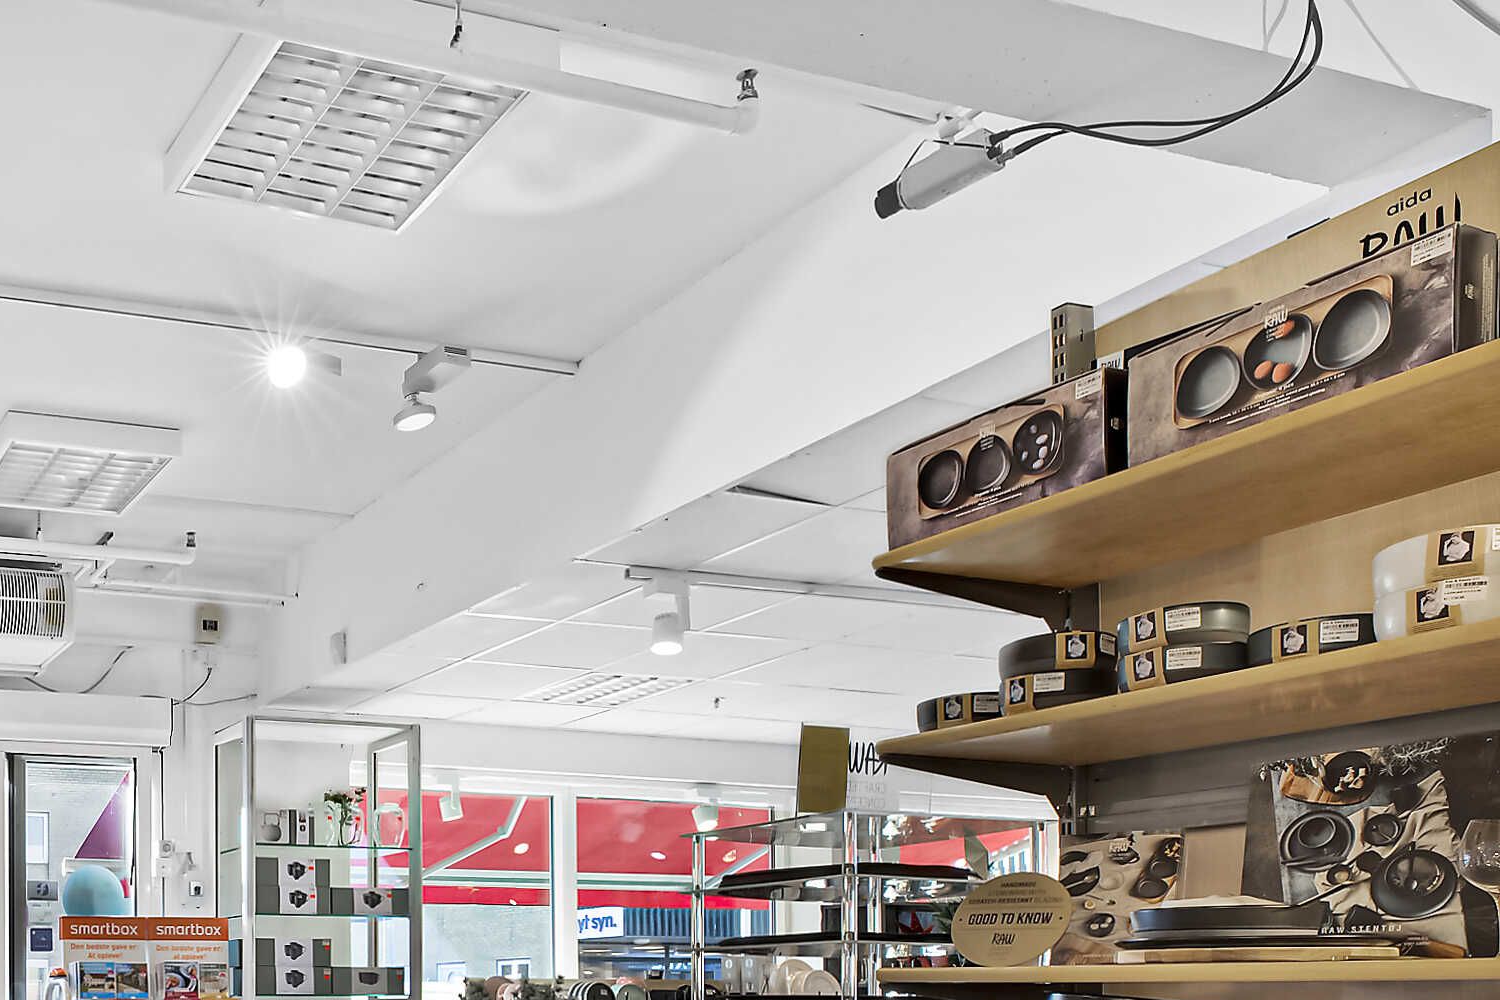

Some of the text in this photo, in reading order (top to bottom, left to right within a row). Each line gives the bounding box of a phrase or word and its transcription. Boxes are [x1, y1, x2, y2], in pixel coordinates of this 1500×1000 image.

[1386, 187, 1432, 216] aida
[1264, 307, 1289, 329] RAW
[591, 915, 617, 932] syn.
[968, 912, 1053, 926] GOOD TO KNOW
[70, 922, 138, 936] smartbox
[155, 923, 222, 936] smartbox
[1320, 926, 1346, 935] RAW
[992, 932, 1016, 945] RAW
[70, 943, 84, 951] Den
[111, 944, 129, 953] gave
